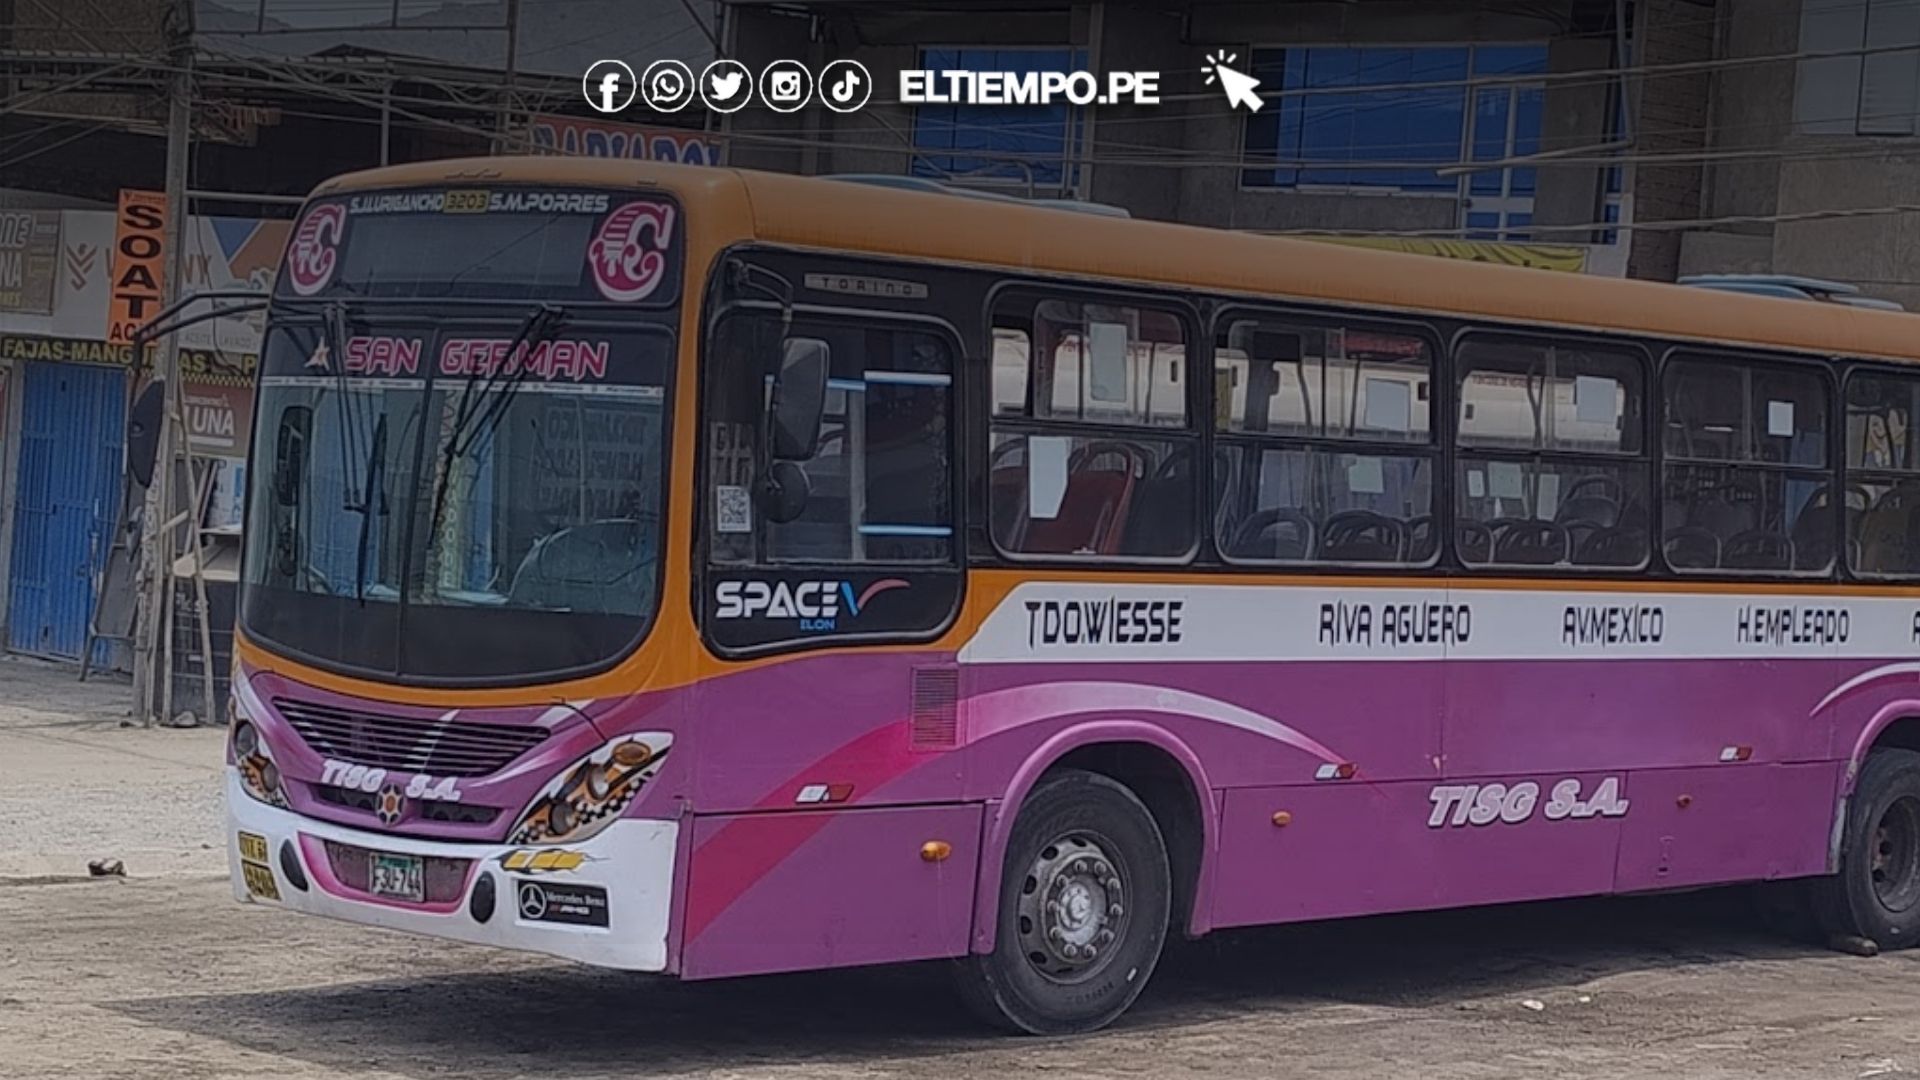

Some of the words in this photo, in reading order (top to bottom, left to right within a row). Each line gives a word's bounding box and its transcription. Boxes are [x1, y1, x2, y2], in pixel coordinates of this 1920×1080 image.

[447, 192, 487, 210] 3203
[489, 193, 610, 213] S.M.PORRES
[115, 204, 163, 319] SOAT
[822, 276, 913, 295] TORINO
[345, 336, 421, 376] SAN
[440, 339, 609, 381] GERMAN
[800, 618, 835, 631] ELON
[1024, 595, 1184, 648] TDO.WIESSE
[1319, 599, 1372, 648] RIVA
[1381, 601, 1472, 648] AGUERO
[1562, 602, 1664, 647] AV.MEXICO
[1737, 605, 1850, 648] H.EMPLEADO
[321, 759, 387, 792] TISG
[405, 774, 462, 801] S.A.
[1426, 782, 1539, 828] TISG
[1544, 776, 1631, 821] S.A.
